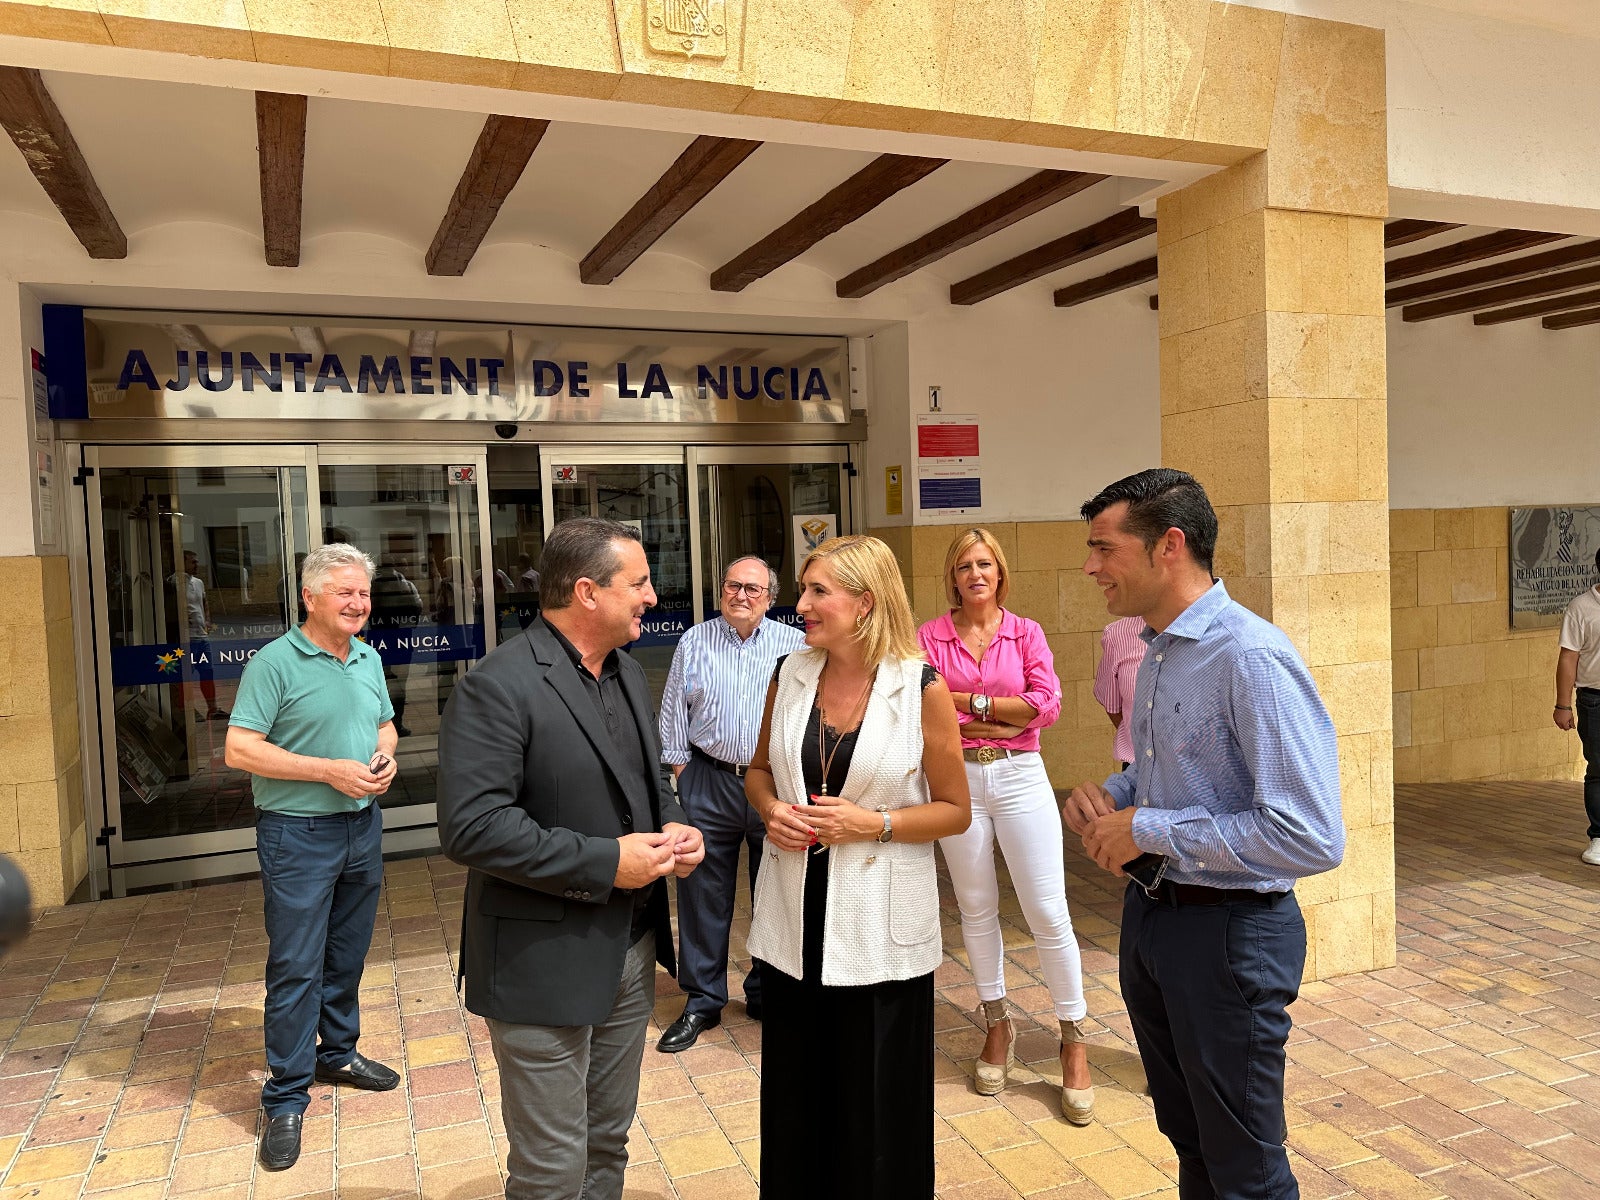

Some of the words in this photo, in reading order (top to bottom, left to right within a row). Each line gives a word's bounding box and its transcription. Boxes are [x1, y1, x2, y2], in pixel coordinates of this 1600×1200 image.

[117, 349, 504, 396] AJUNTAMENT
[532, 359, 590, 398] DE
[617, 362, 674, 400] LA
[697, 364, 832, 401] NUCIA
[931, 390, 938, 408] 1
[1561, 578, 1570, 589] DE
[519, 609, 531, 617] LA
[371, 616, 384, 625] LA
[222, 626, 236, 635] LA
[370, 638, 388, 650] LA
[190, 651, 209, 664] LA
